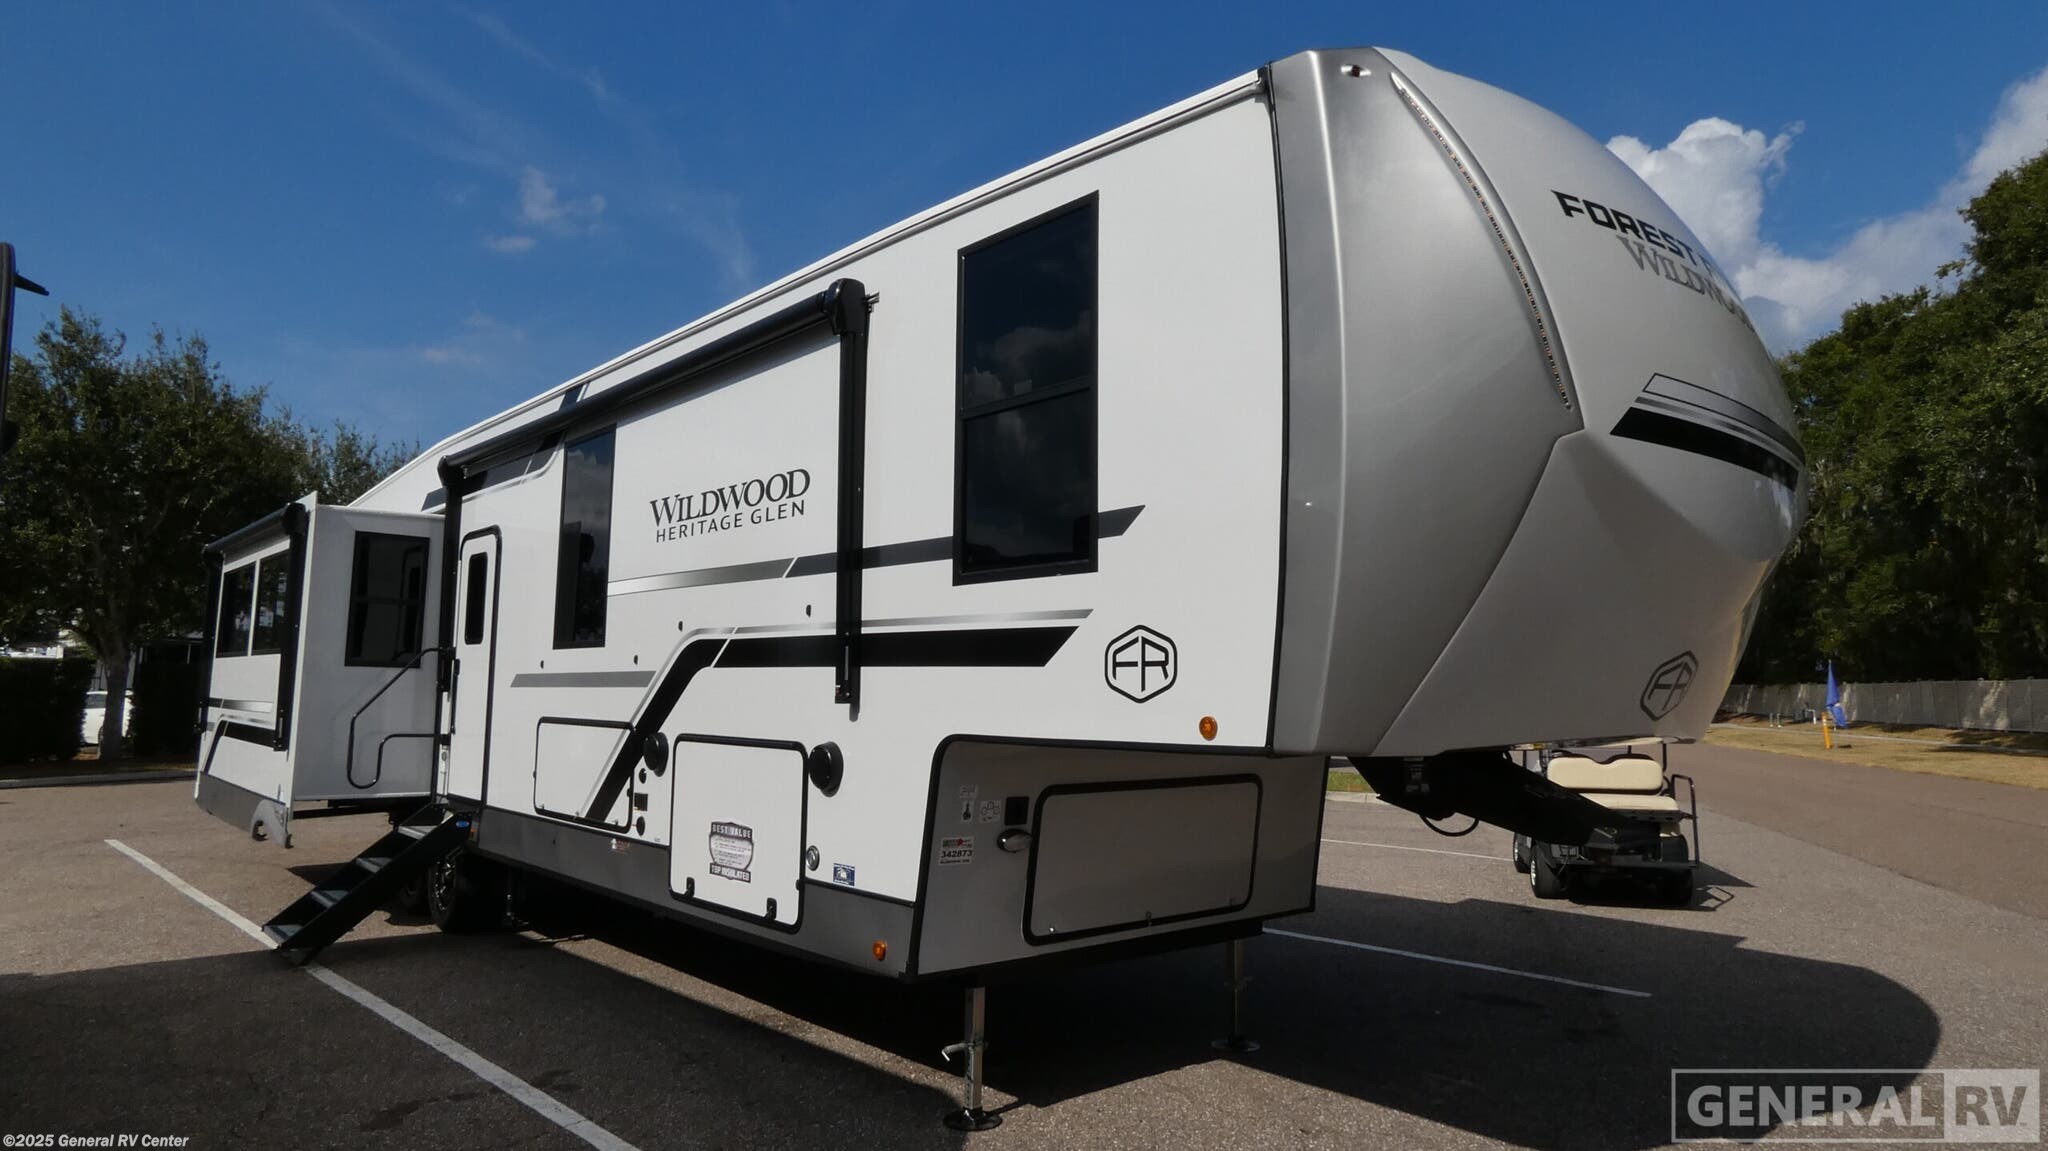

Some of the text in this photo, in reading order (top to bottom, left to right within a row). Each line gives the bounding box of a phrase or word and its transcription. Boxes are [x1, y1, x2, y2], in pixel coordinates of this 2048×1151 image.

[1551, 189, 1698, 267] FOREST
[1615, 233, 1756, 334] WILDWO
[649, 468, 811, 527] WILDWOOD
[656, 499, 805, 543] HERITAGE GLEN
[712, 824, 751, 838] BEST VALUE
